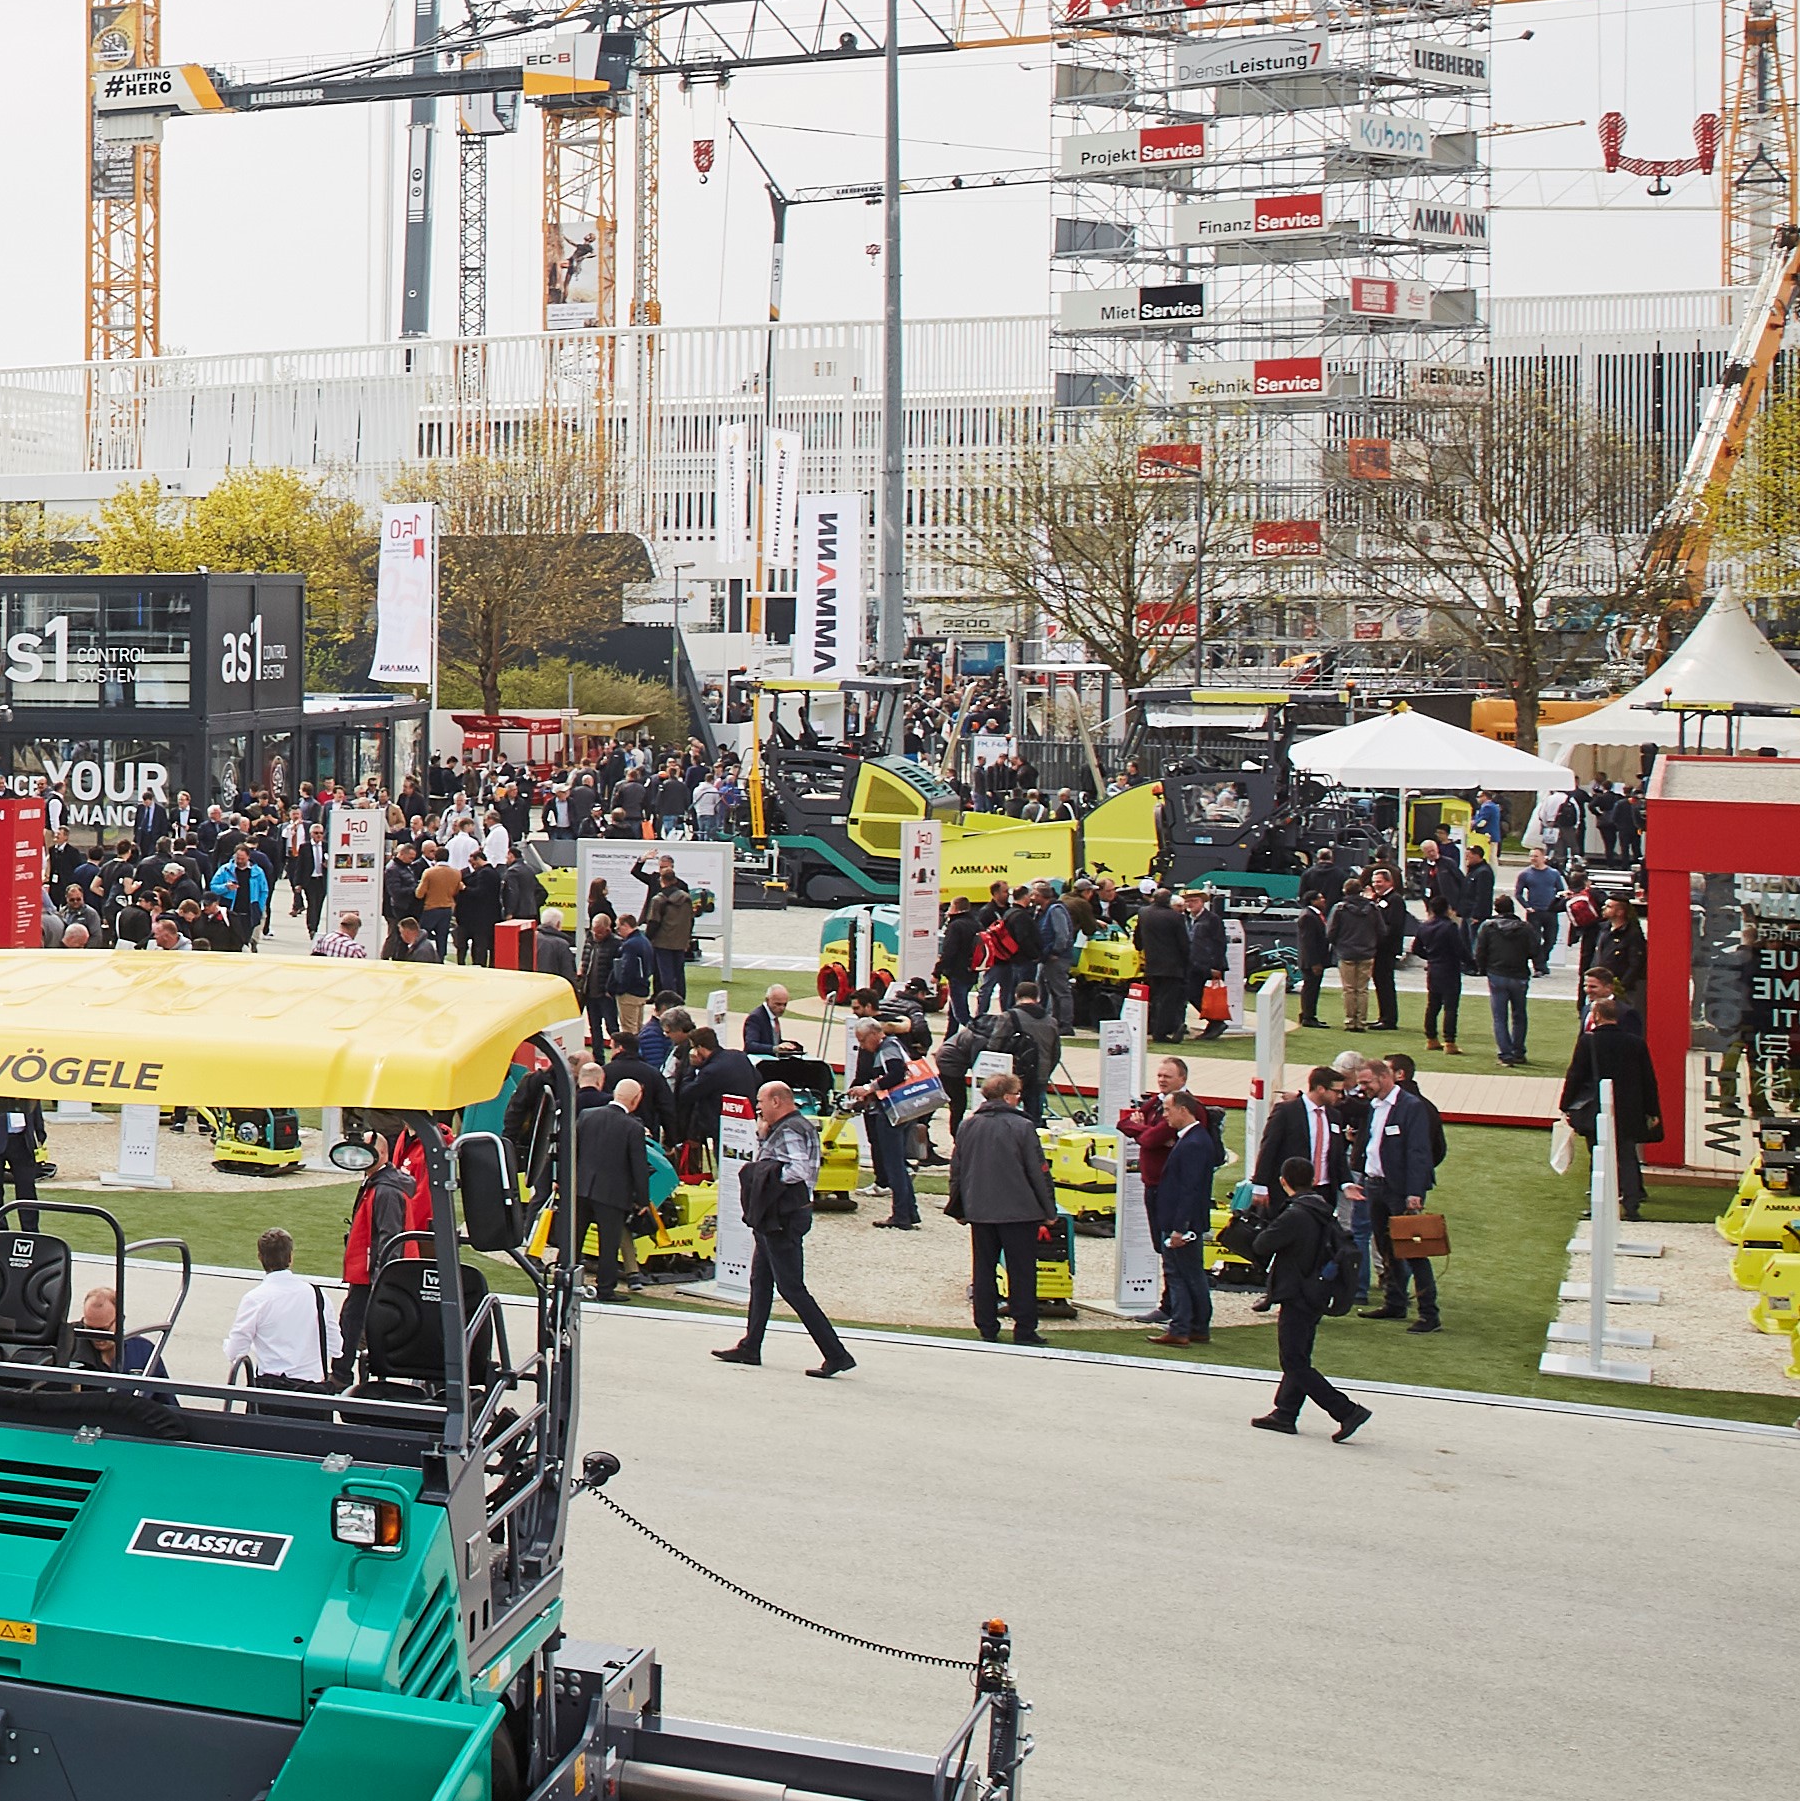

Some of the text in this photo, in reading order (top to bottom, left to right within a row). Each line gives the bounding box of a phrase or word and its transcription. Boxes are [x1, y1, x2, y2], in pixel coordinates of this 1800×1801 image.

[1309, 42, 1322, 65] 7
[1179, 51, 1308, 82] DienstLeistung
[1414, 48, 1485, 79] LIEBHERR
[126, 71, 171, 82] LIFTING
[126, 82, 171, 96] HERO
[251, 89, 323, 104] LIEBHERR
[1360, 119, 1425, 152] Kubota
[1081, 142, 1202, 166] Projekt Service
[1198, 212, 1321, 234] Finanz Service
[1413, 208, 1485, 237] AMMANN
[1101, 301, 1201, 320] Miet Service
[1189, 375, 1320, 395] Technik Service
[1420, 367, 1485, 387] HERKULES
[77, 647, 151, 664] CONTROL
[263, 645, 288, 660] CONTROL
[77, 668, 141, 684] SYSTEM
[263, 664, 284, 680] SYSTEM
[43, 761, 168, 803] YOUR
[345, 818, 368, 833] 150
[950, 865, 1008, 875] AMMANN
[722, 1102, 744, 1113] NEW
[157, 1531, 252, 1558] CLASSIC
